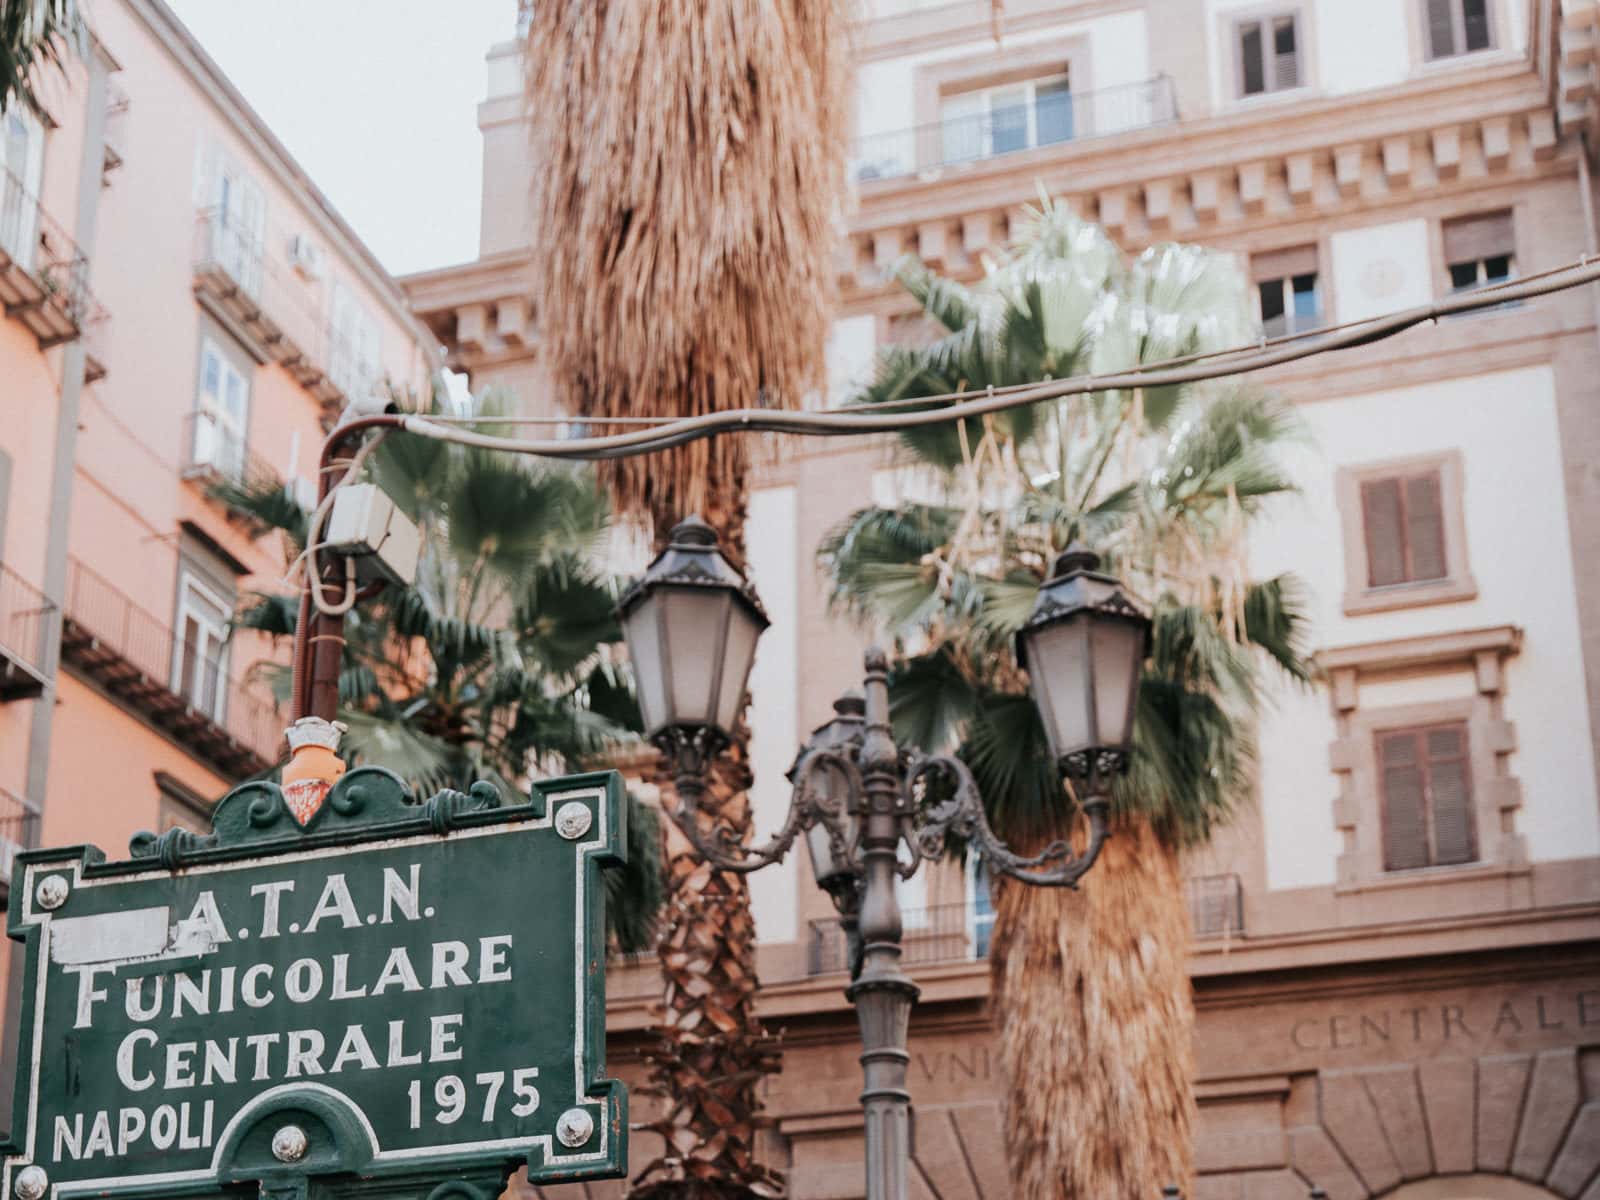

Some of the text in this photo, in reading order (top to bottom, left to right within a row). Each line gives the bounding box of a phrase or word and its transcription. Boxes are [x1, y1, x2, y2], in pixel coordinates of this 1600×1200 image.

[177, 864, 435, 944] A.T.A.N.
[64, 934, 514, 1029] FUNICOLARE
[1290, 990, 1600, 1049] CENTRALE
[116, 1013, 463, 1091] CENTRALE
[53, 1067, 540, 1162] NAPOLI 1975
